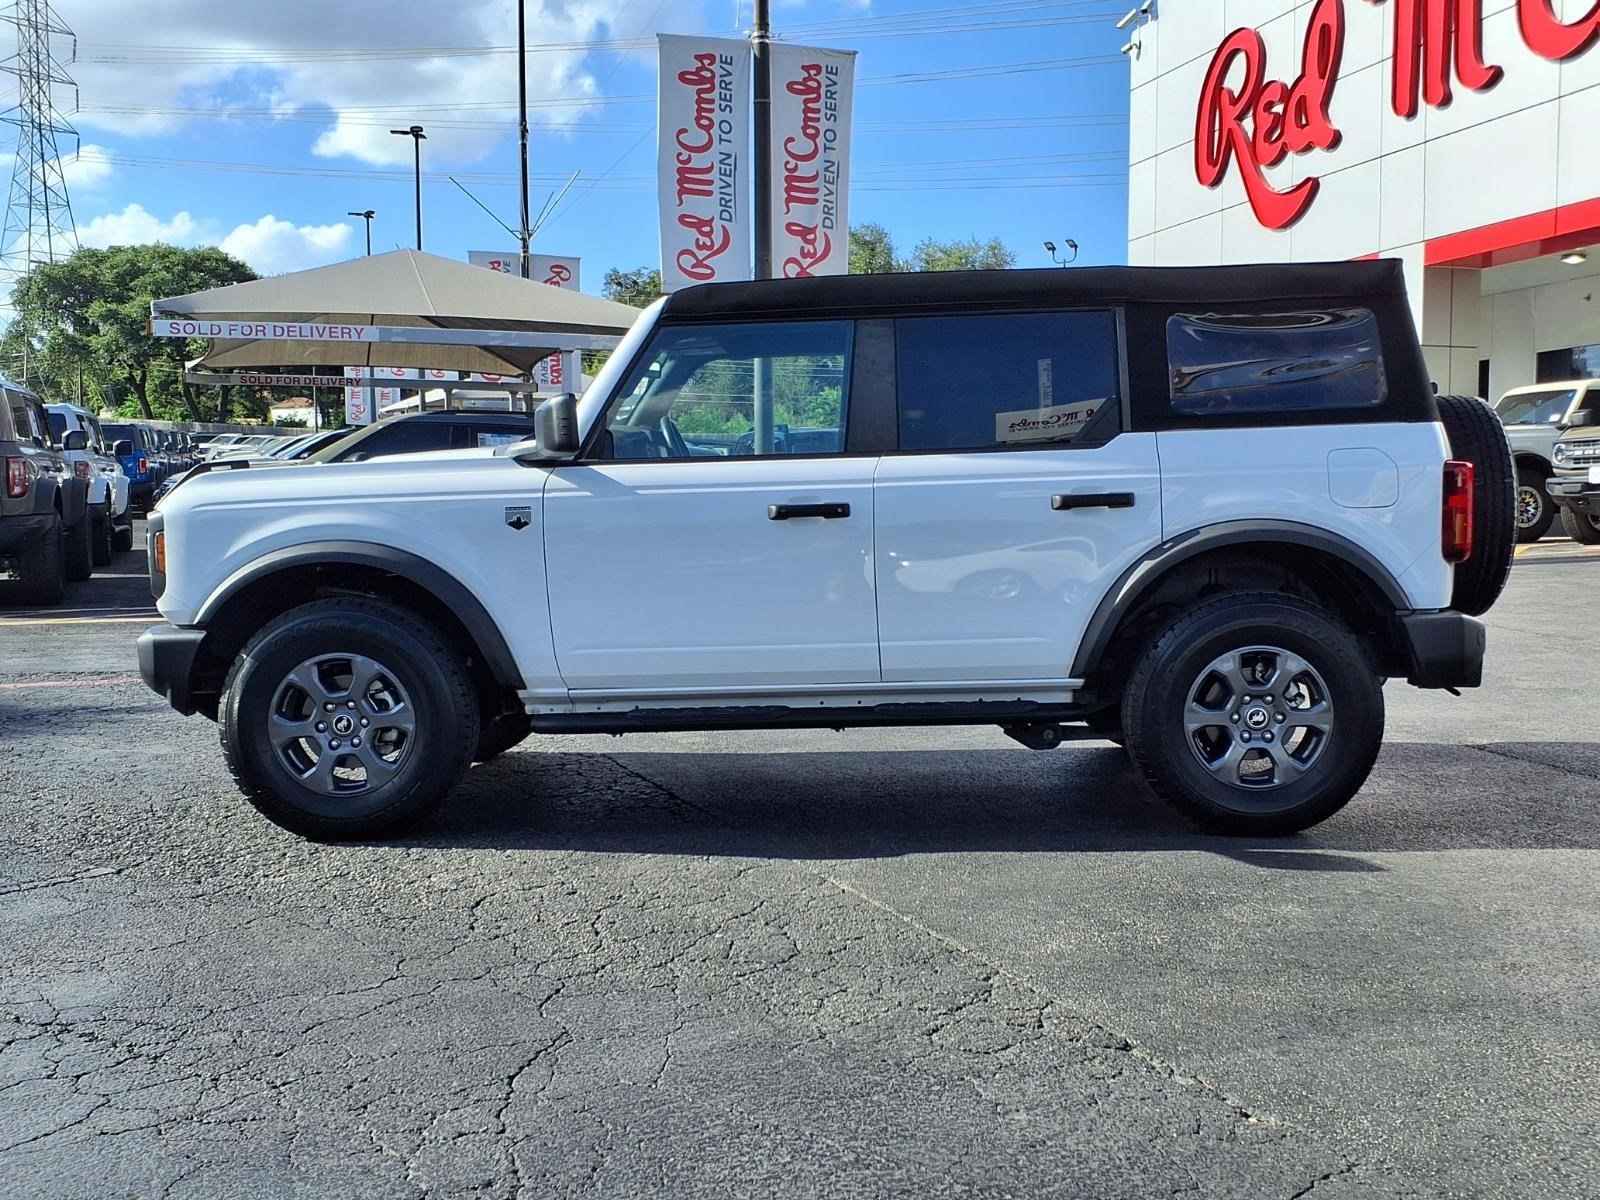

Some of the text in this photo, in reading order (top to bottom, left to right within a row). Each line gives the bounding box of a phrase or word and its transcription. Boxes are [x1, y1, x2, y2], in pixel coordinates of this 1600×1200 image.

[719, 53, 734, 223] DRIVEN TO SERVE
[823, 64, 839, 231] DRIVEN TO SERVE
[1195, 0, 1344, 230] Red
[676, 52, 731, 281] Red McCombs
[783, 63, 832, 279] Red McCombs
[542, 264, 572, 288] Re
[169, 322, 365, 340] SOLD FOR DELIVERY
[541, 360, 549, 385] ERVE
[240, 375, 362, 387] SOLD FOR DELIVERY
[351, 403, 366, 421] Red
